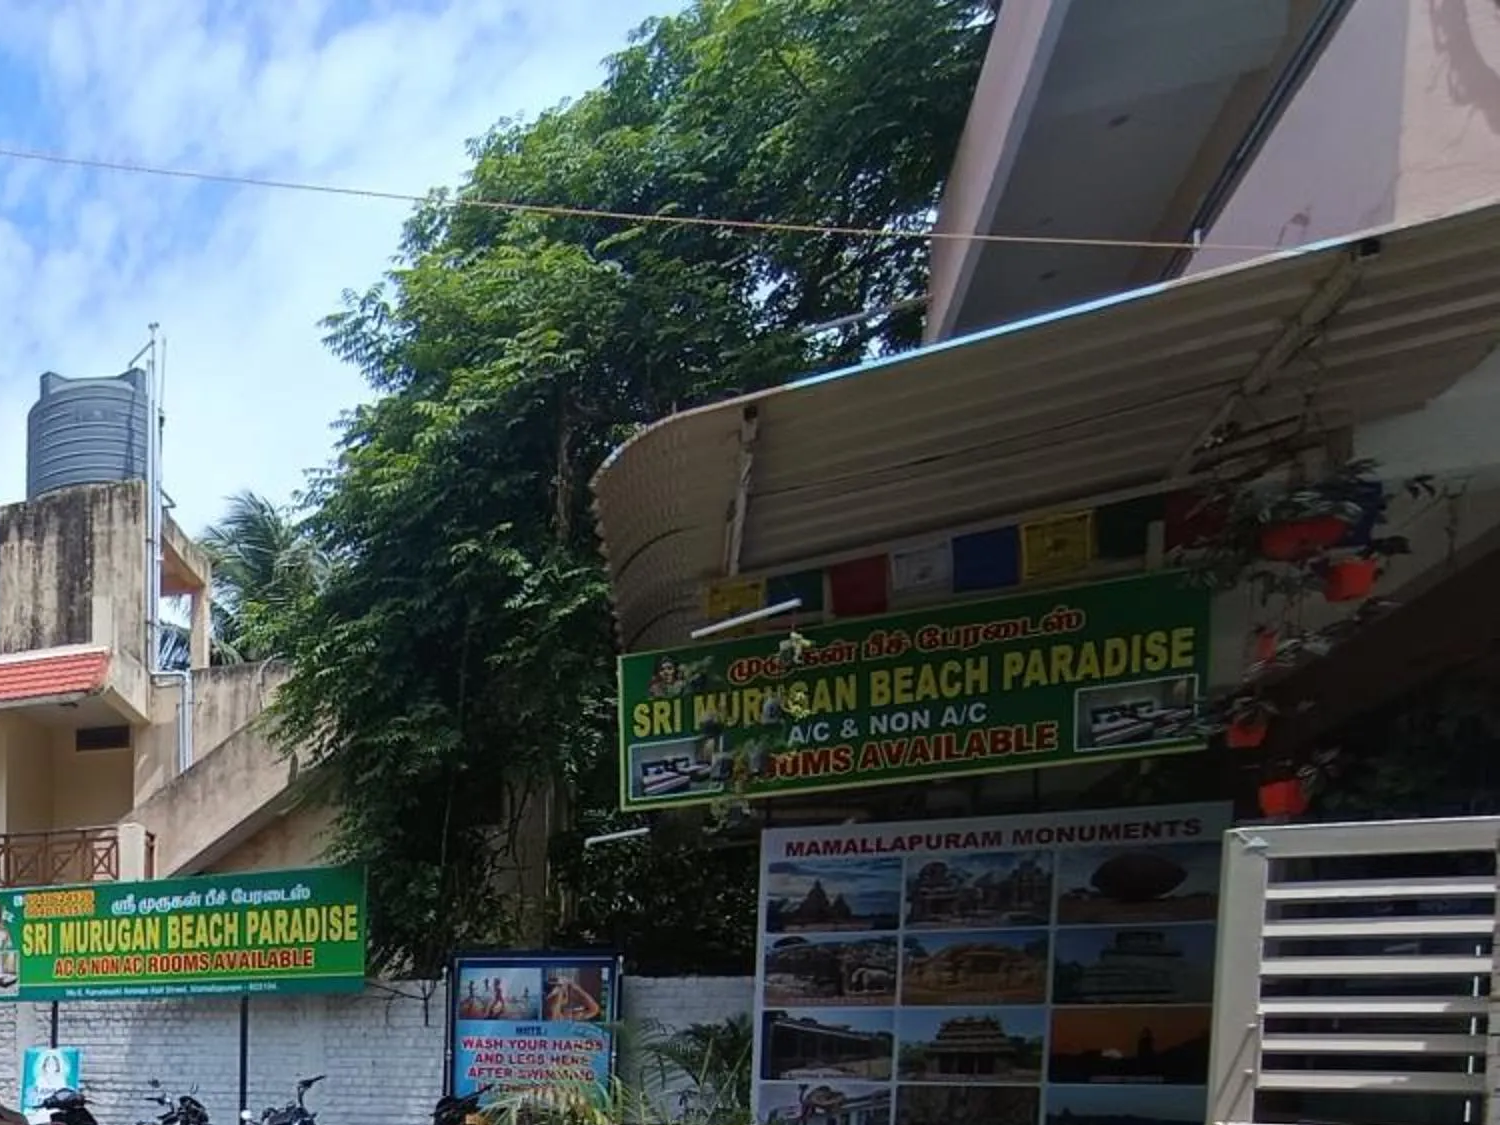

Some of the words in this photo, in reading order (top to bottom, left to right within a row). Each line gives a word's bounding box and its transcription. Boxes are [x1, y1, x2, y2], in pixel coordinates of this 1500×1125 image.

[633, 698, 681, 739] SRI
[870, 655, 989, 706] BEACH
[1002, 626, 1196, 691] PARADISE
[788, 722, 830, 747] A/C
[840, 718, 859, 739] &
[870, 709, 930, 735] NON
[940, 702, 987, 728] A/C
[859, 720, 1058, 771] AVAILABLE
[785, 830, 1003, 857] MAMALLAPURAM
[1012, 818, 1203, 846] MONUMENTS
[22, 922, 52, 956] SRI
[60, 915, 160, 954] MURUGAN
[167, 911, 238, 950] BEACH
[246, 904, 358, 946] PARADISE
[55, 957, 73, 977] AC
[91, 955, 119, 975] NON
[123, 954, 142, 974] AC
[149, 952, 209, 973] ROOMS
[214, 948, 314, 971] AVAILABLE
[462, 1038, 502, 1050] WASH
[510, 1038, 547, 1051] YOUR
[553, 1039, 603, 1051] HANDS
[475, 1053, 504, 1065] AND
[510, 1053, 545, 1065] LEGS
[467, 1067, 513, 1078] AFTER
